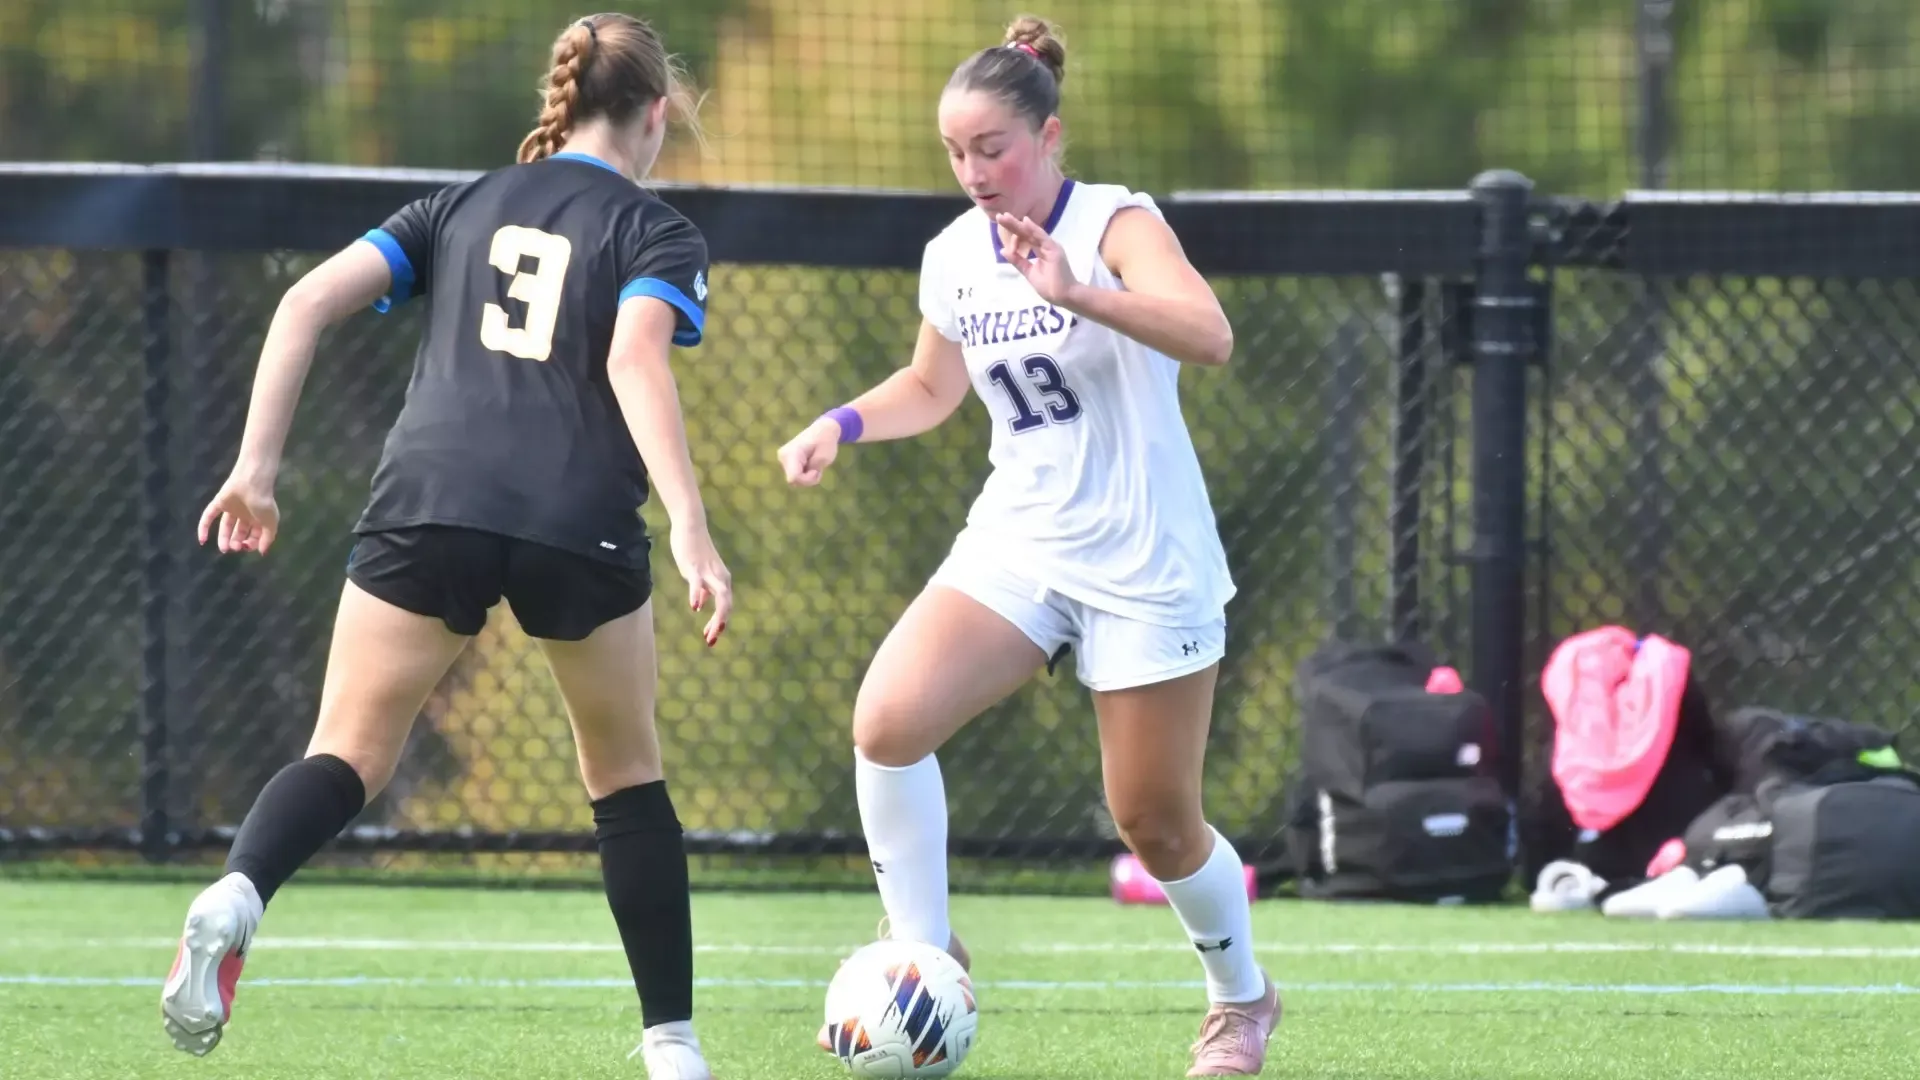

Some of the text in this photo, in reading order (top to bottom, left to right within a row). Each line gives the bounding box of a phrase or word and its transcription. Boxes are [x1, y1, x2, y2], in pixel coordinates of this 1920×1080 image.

[480, 224, 571, 362] 3
[959, 304, 1078, 348] MHERS
[985, 353, 1083, 436] 13
